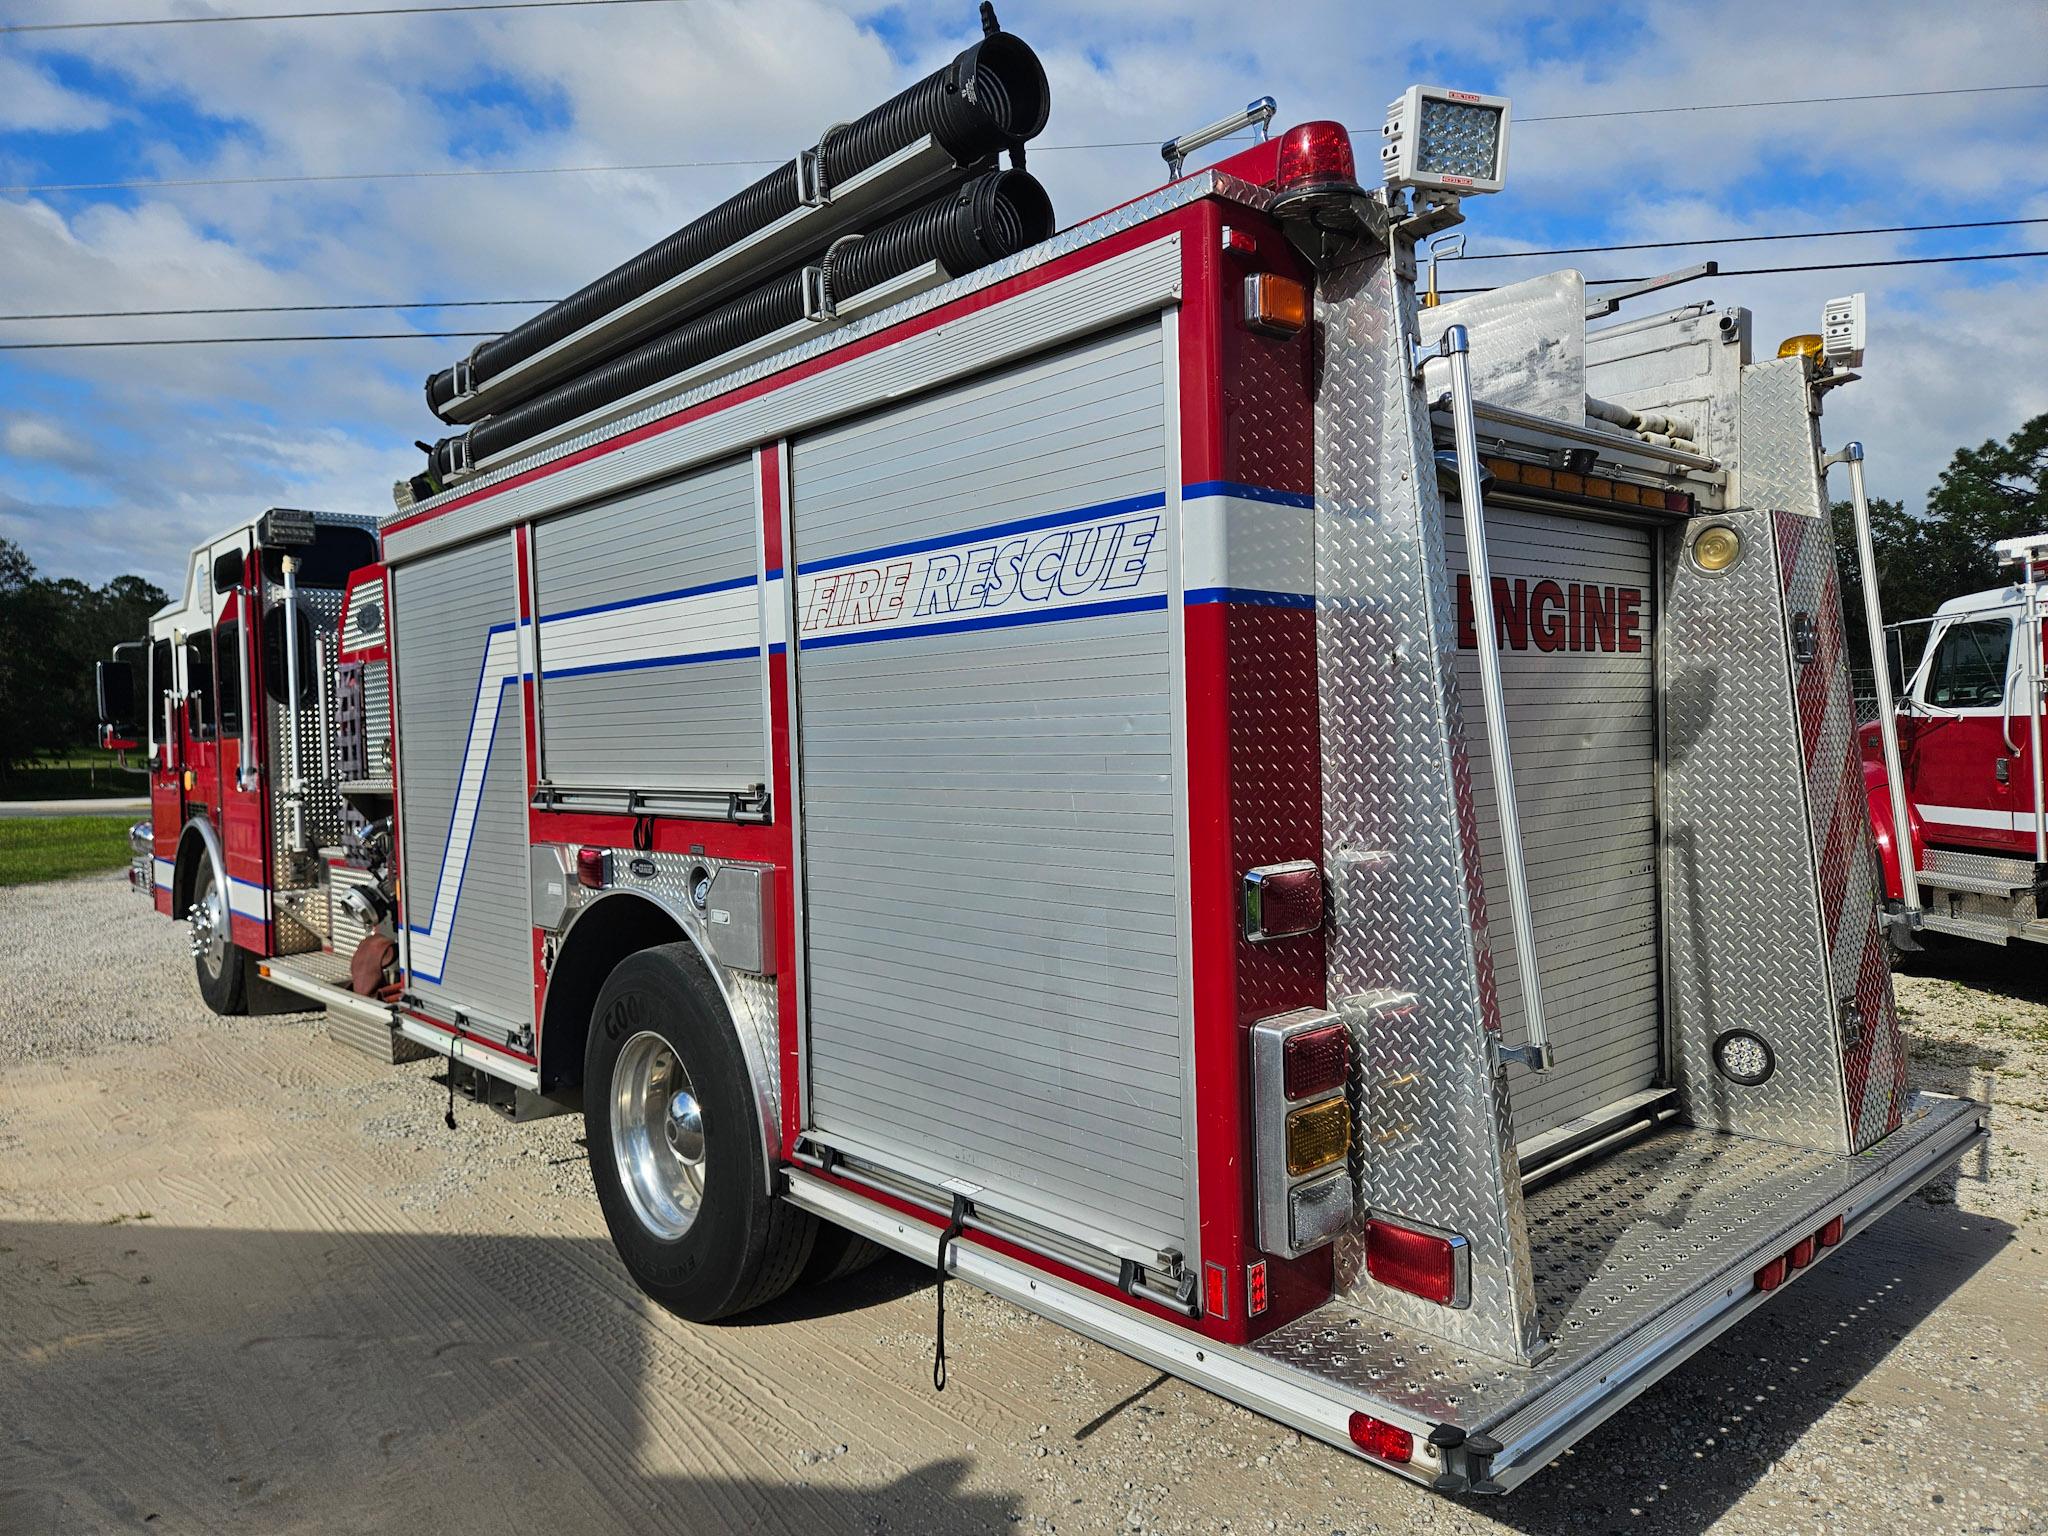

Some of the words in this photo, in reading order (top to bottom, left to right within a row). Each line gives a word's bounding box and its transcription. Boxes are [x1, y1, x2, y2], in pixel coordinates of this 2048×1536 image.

[802, 562, 913, 631] FIRE
[913, 515, 1160, 617] RESCUE
[1457, 573, 1642, 653] ENGINE
